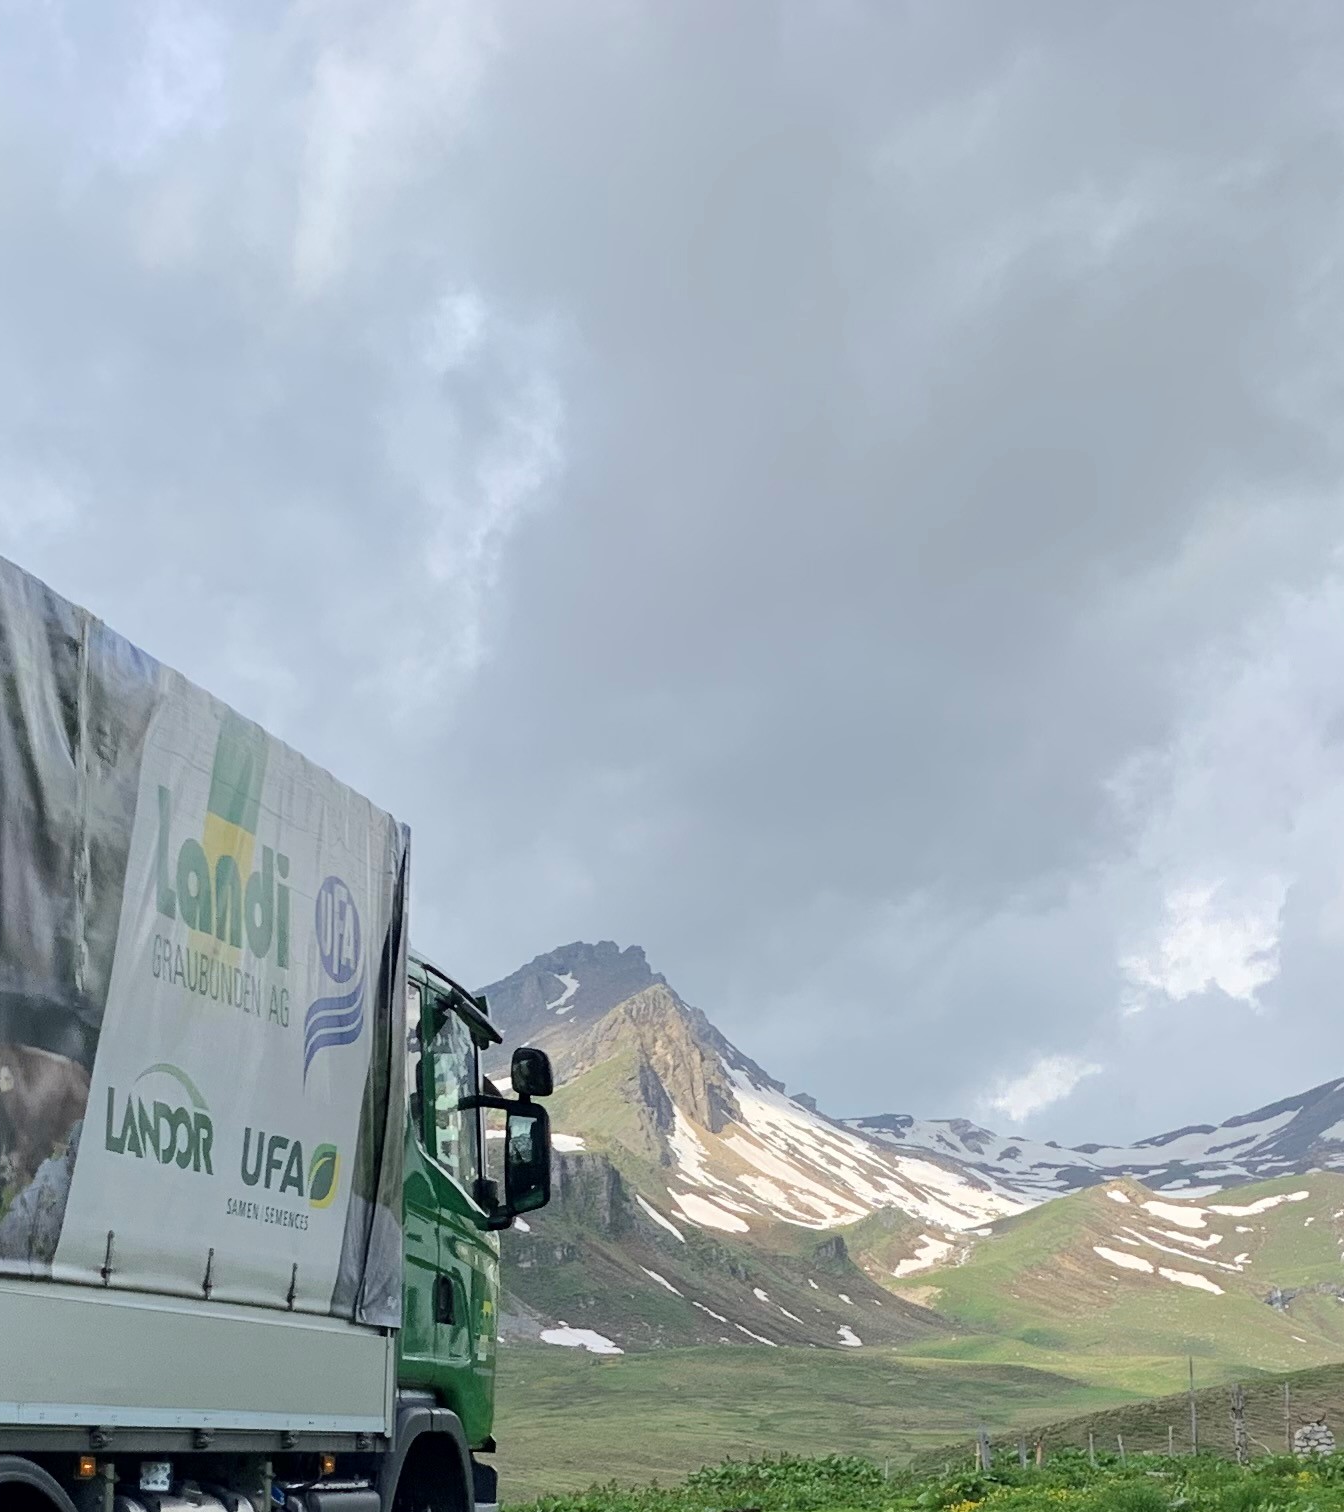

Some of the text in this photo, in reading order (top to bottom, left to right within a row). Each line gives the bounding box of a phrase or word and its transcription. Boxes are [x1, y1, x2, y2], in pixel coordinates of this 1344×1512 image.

[156, 784, 290, 970] Landi
[320, 883, 357, 976] UFA
[269, 984, 290, 1028] AG
[106, 1086, 214, 1175] LANDOR
[241, 1127, 304, 1197] UFA
[226, 1198, 309, 1231] SAMEN SEMENCES
